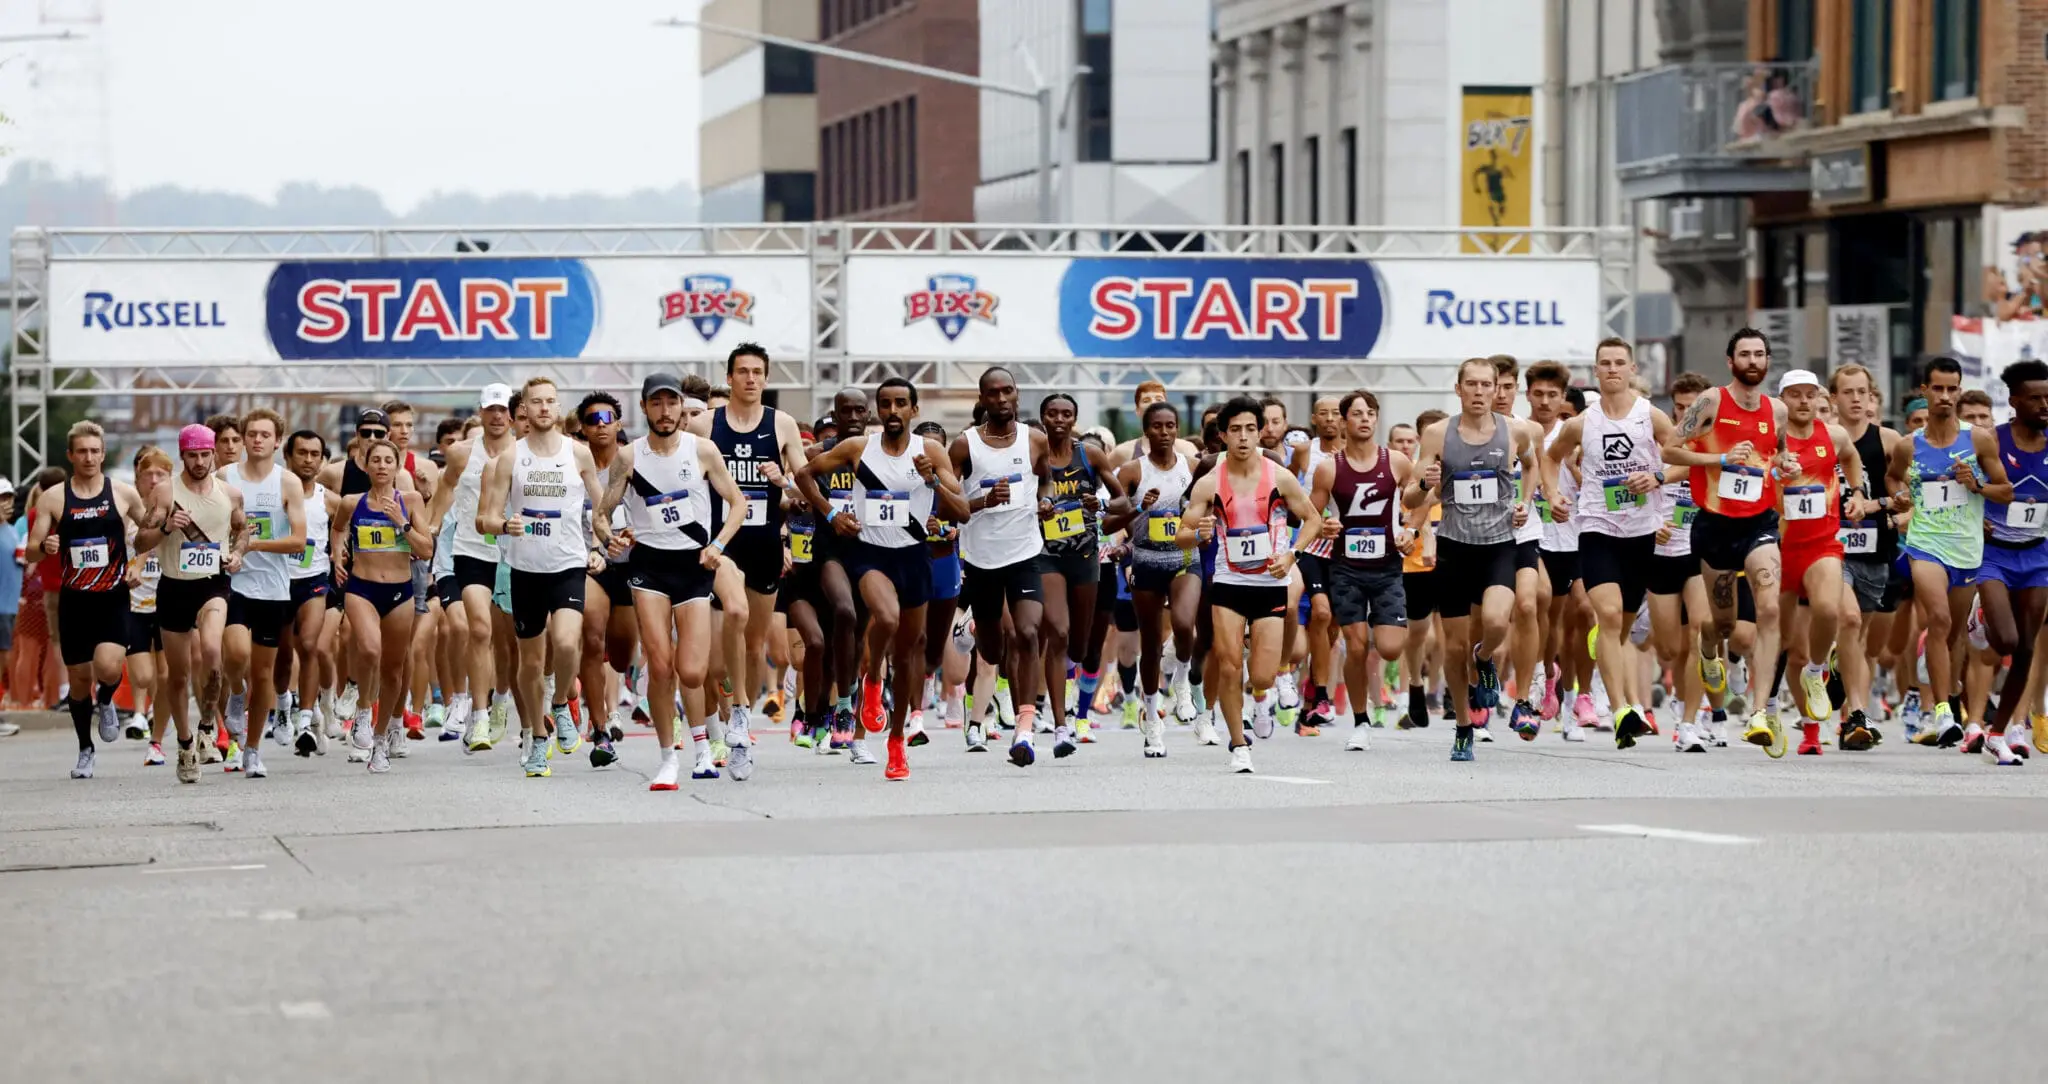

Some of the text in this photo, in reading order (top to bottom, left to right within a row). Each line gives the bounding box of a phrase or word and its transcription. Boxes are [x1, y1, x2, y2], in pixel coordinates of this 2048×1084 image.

[298, 279, 568, 342] START
[1088, 277, 1358, 341] START
[527, 470, 564, 483] CROWN
[523, 484, 568, 497] RUNNING
[1470, 482, 1483, 500] 11
[1733, 478, 1749, 496] 51
[1940, 485, 1949, 502] 7
[879, 504, 895, 521] 31
[1798, 497, 1813, 514] 41
[661, 505, 681, 524] 35
[2024, 507, 2036, 523] 17
[530, 521, 551, 538] 166
[1056, 516, 1071, 532] 12
[1162, 521, 1175, 537] 16
[369, 530, 382, 545] 10
[1846, 532, 1867, 548] 139
[1240, 539, 1256, 557] 27
[1357, 539, 1376, 554] 129
[80, 549, 100, 563] 186
[187, 552, 214, 567] 205
[145, 560, 161, 573] 161
